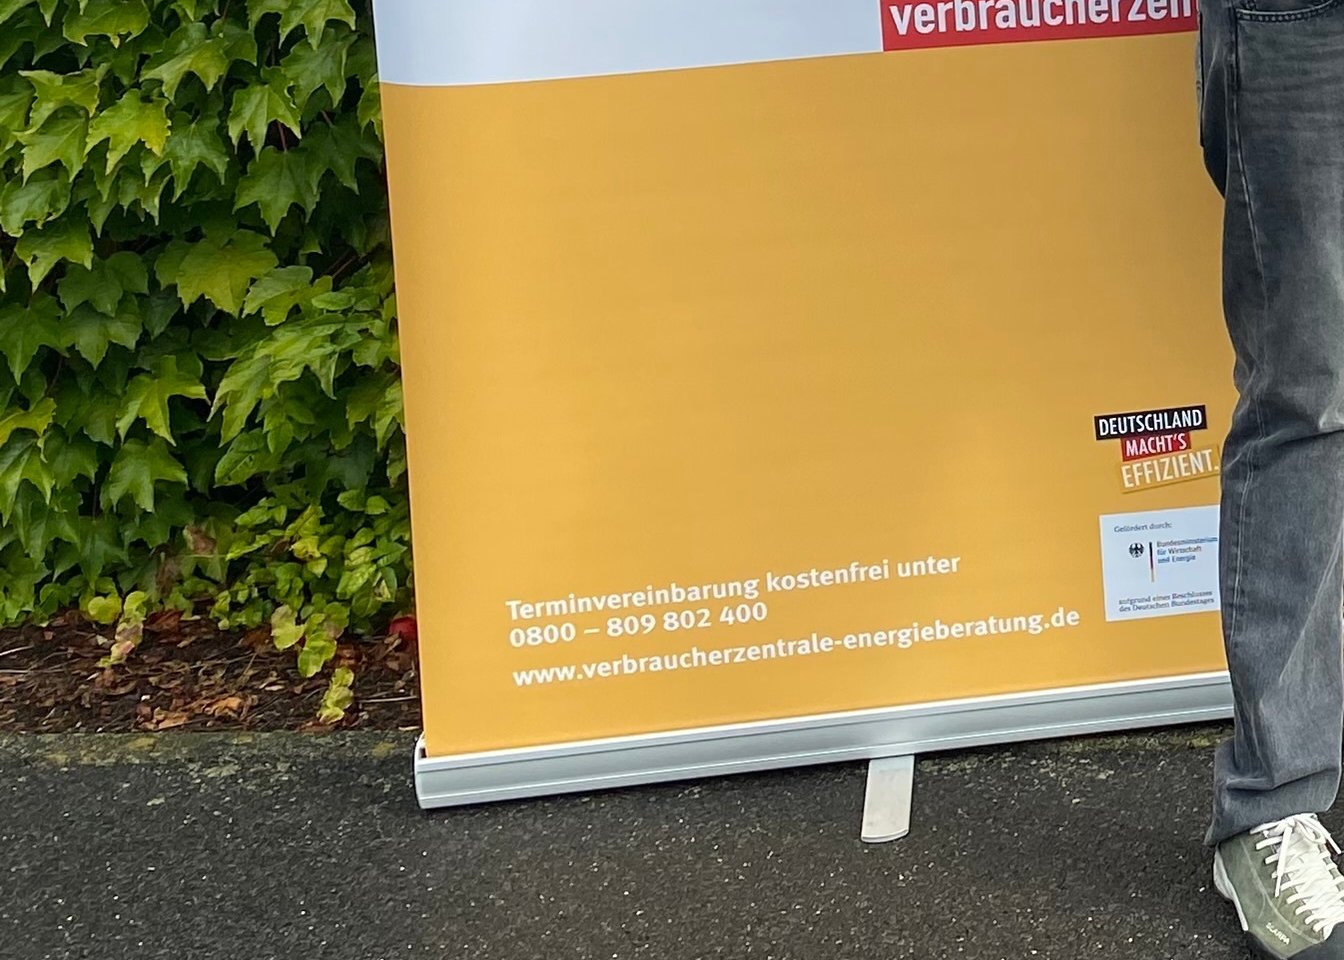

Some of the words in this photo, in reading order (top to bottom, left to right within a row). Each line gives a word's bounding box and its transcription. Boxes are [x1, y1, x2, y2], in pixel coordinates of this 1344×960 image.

[1099, 408, 1202, 436] DEUTSCHLAND
[1121, 449, 1219, 488] EFFIZIENT.
[506, 579, 760, 620] Terminvereinbarung
[767, 560, 889, 592] kostenfrei
[898, 556, 960, 577] unter
[510, 623, 575, 647] 0800
[607, 614, 656, 636] 809
[663, 609, 711, 630] 802
[720, 602, 767, 624] 400
[511, 607, 1080, 687] www.verbraucherzentrale-energieberatung.de
